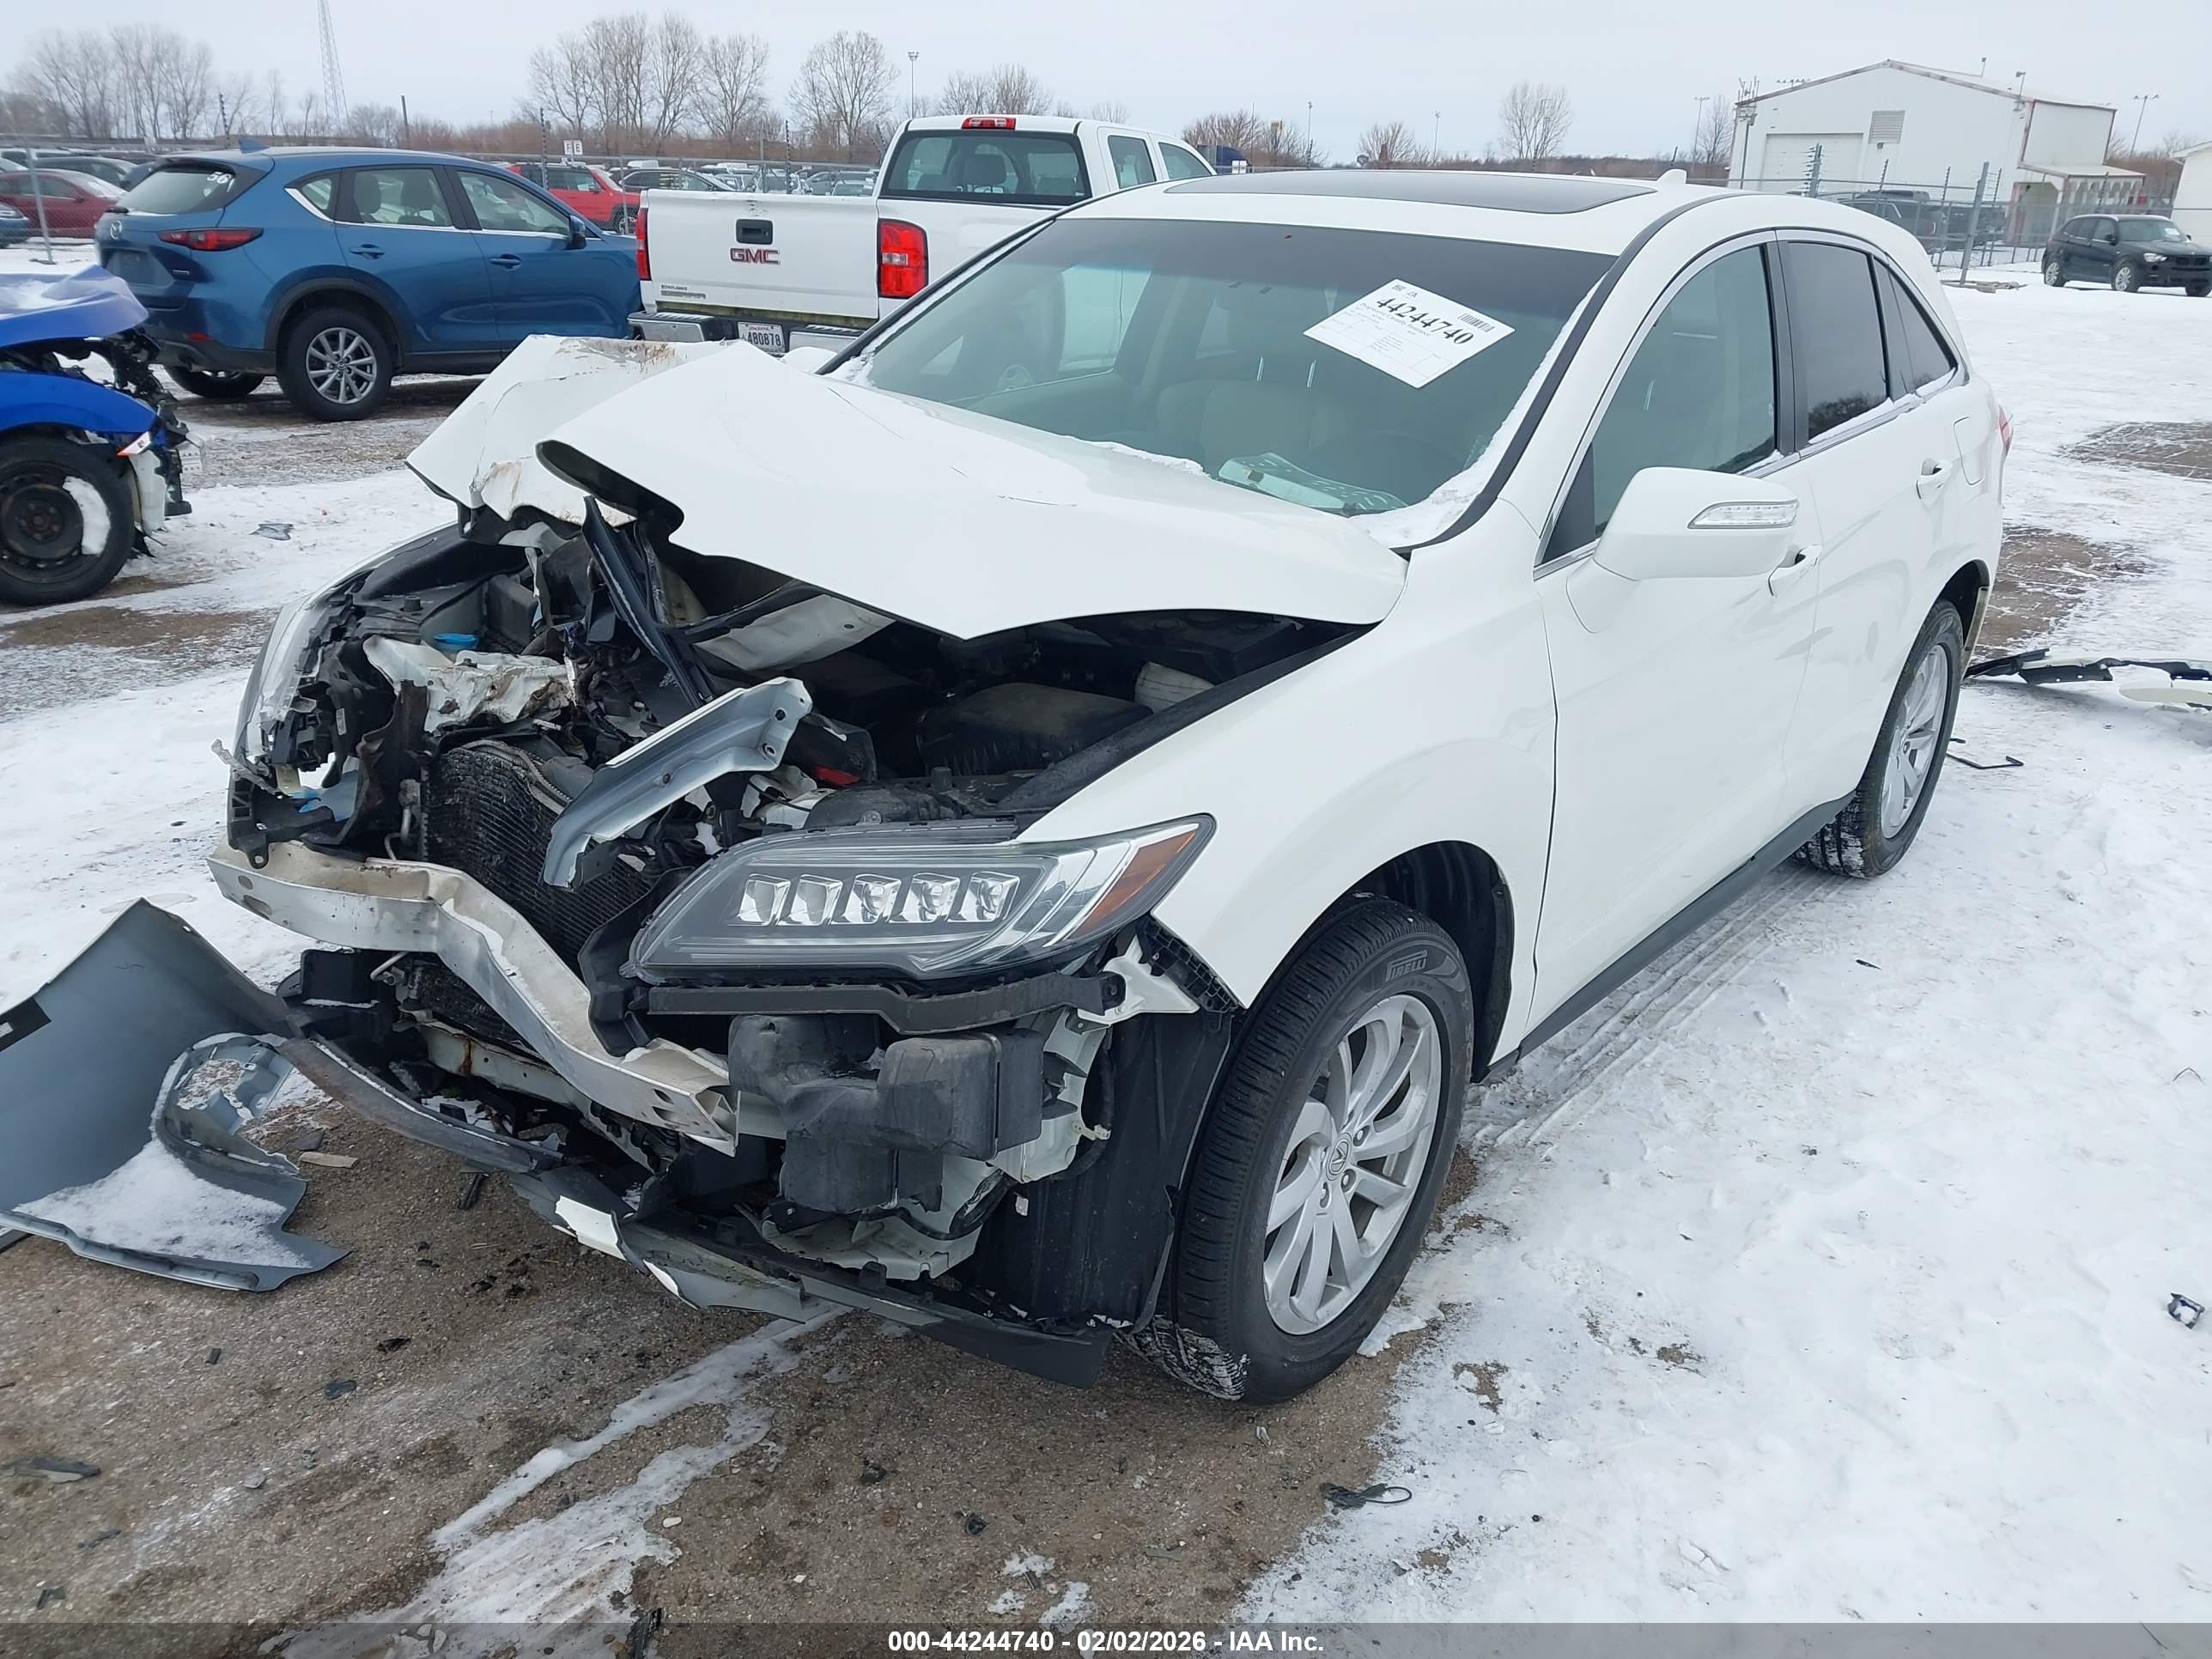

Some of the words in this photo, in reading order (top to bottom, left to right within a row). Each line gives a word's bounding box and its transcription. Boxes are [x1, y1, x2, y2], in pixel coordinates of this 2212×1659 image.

[730, 247, 781, 265] GMC
[1370, 295, 1479, 345] 44244740
[1385, 949, 1429, 983] PIRELLI
